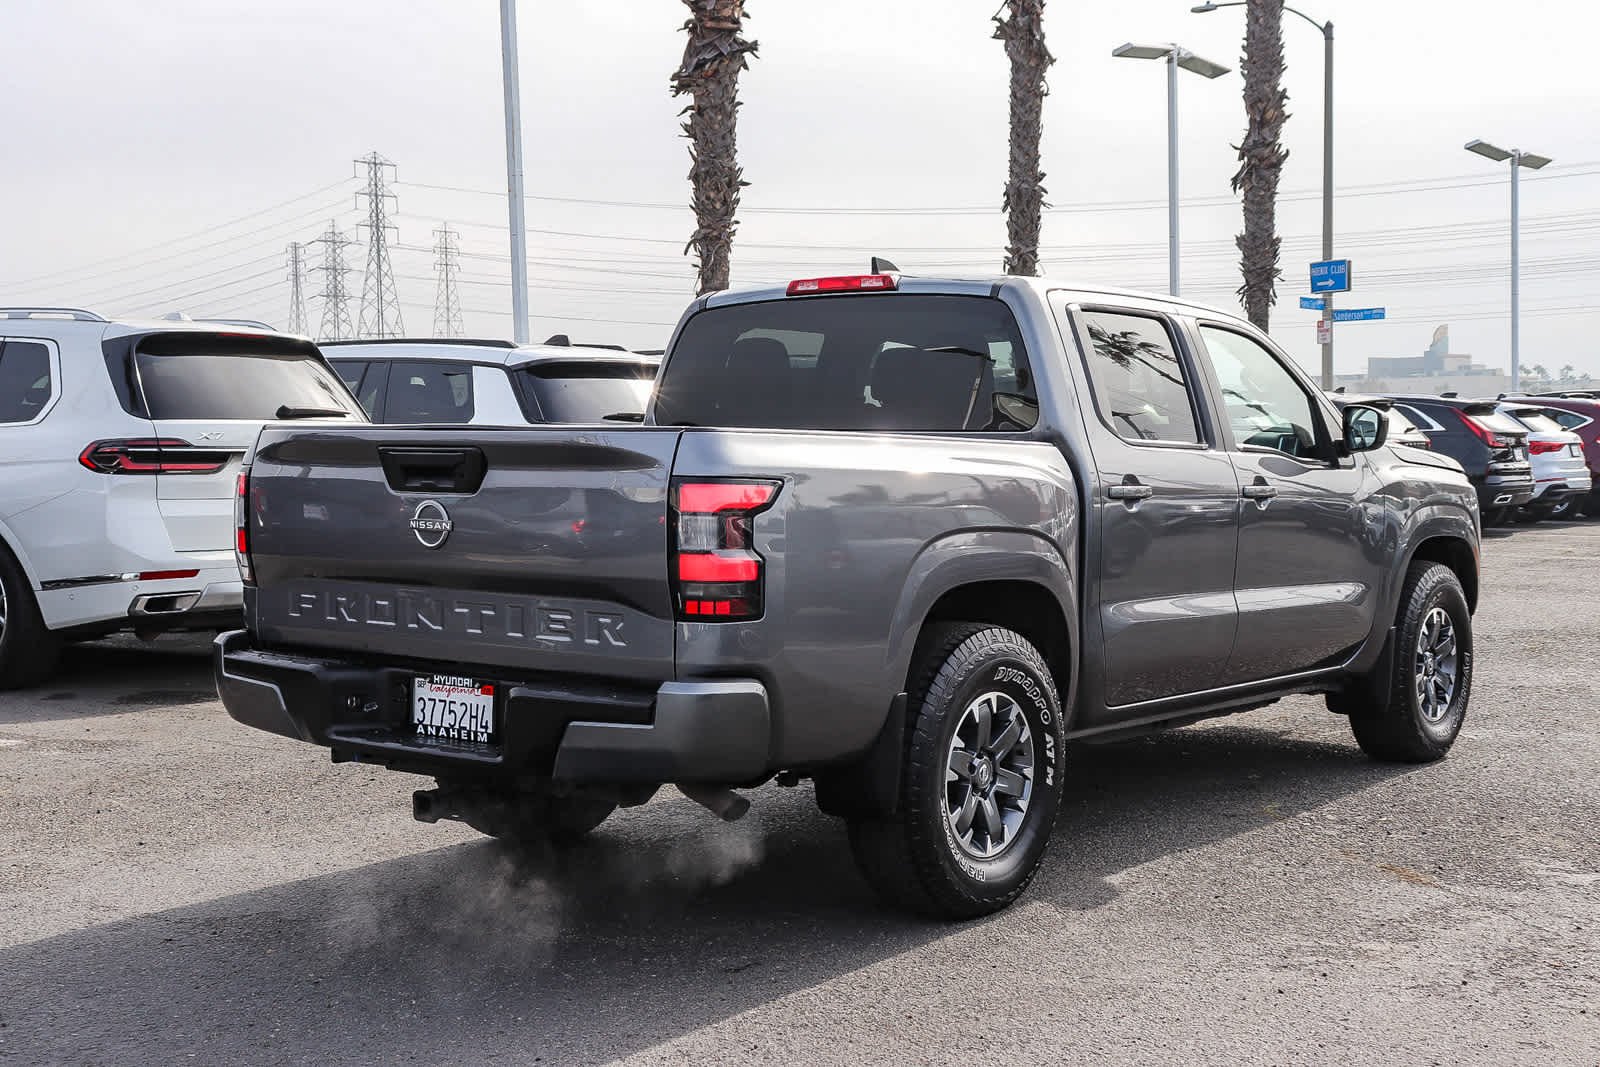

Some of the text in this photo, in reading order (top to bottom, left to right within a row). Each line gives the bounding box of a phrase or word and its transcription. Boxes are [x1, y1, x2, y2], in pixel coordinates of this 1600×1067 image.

[1330, 264, 1346, 274] CLUB
[410, 520, 450, 530] NISSAN
[288, 592, 627, 647] FRONTIER
[433, 674, 473, 688] HYUNDAI
[429, 684, 478, 698] California
[416, 697, 489, 731] 37752H4
[416, 724, 489, 742] ANAHEIM
